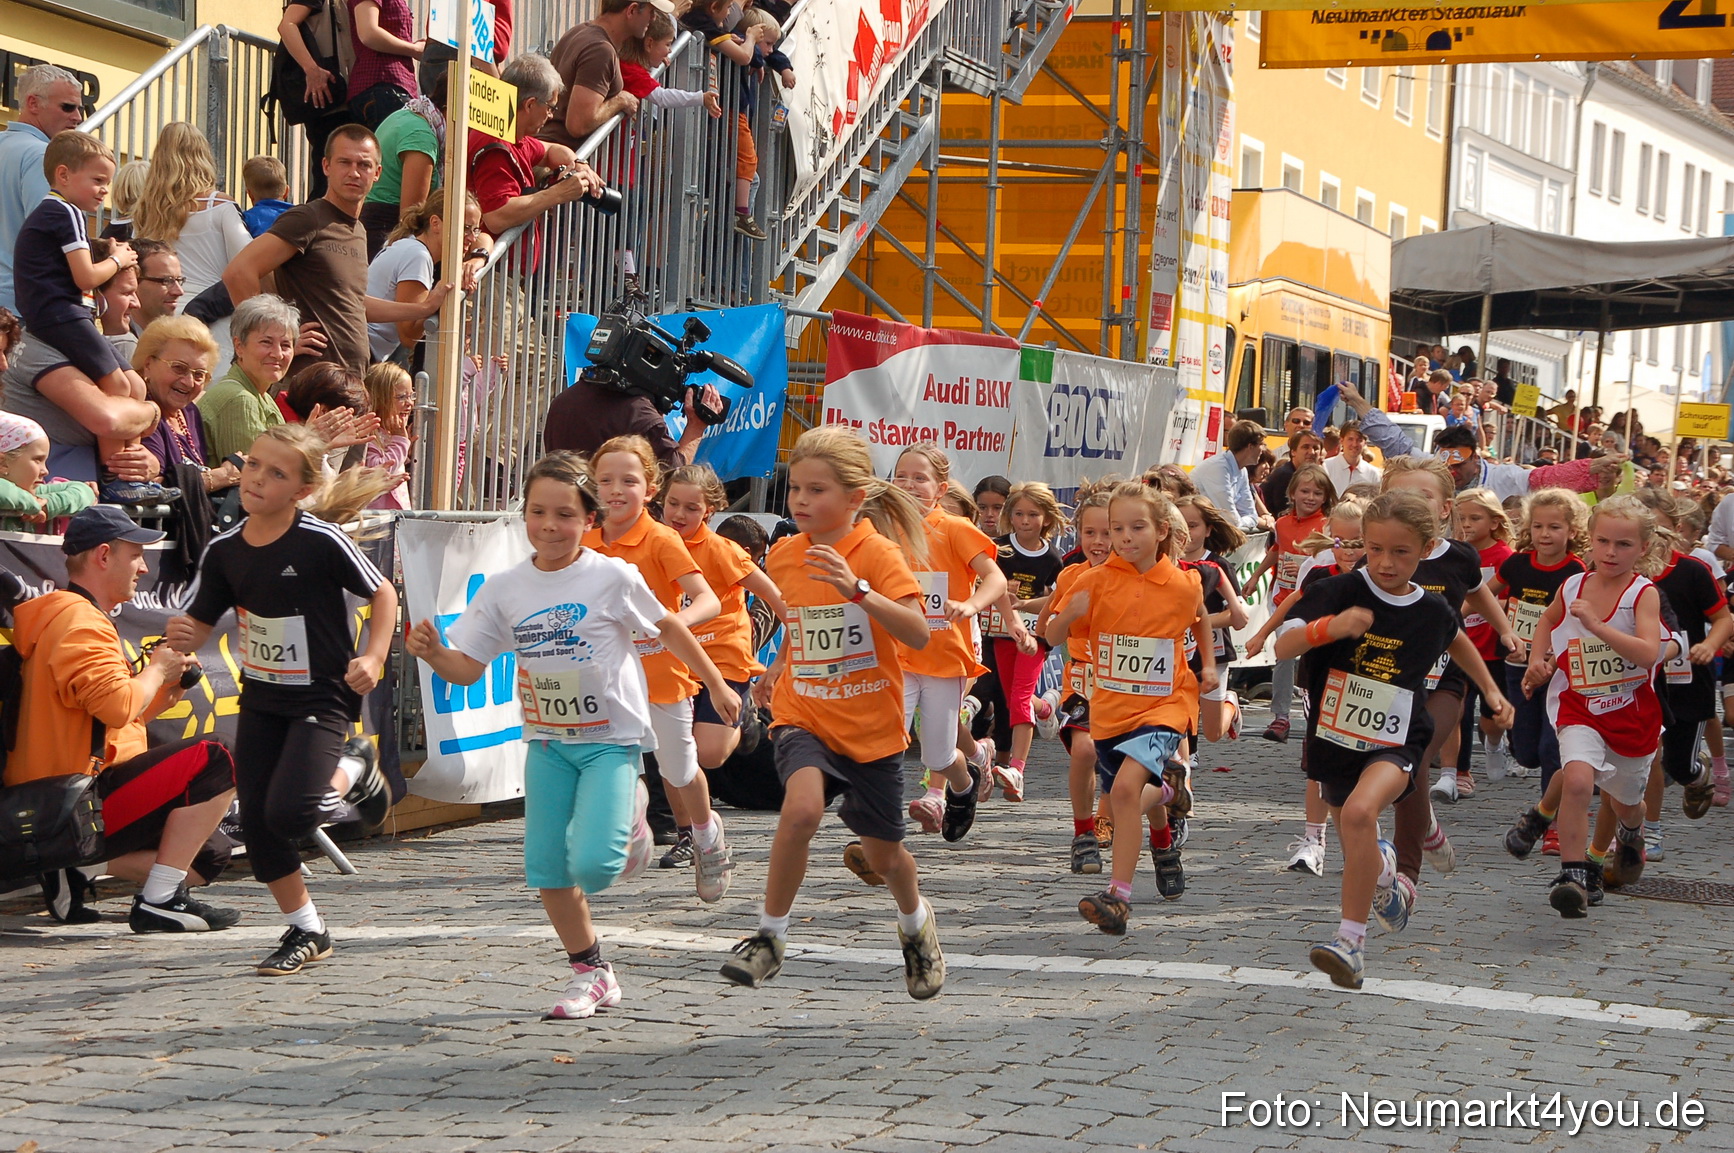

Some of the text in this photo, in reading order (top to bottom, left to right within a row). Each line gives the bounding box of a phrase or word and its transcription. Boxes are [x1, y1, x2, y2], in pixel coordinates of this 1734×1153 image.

[1311, 8, 1432, 24] Neumarkter
[923, 373, 970, 406] Audi
[868, 417, 940, 447] starker
[133, 581, 164, 610] und
[806, 624, 863, 651] 7075
[1116, 634, 1140, 648] Elisa
[1583, 642, 1611, 654] Laura
[250, 640, 298, 663] 7021
[555, 648, 575, 657] Sport
[1116, 654, 1167, 675] 7074
[534, 677, 561, 691] Julia
[842, 678, 891, 699] Reisen
[1347, 680, 1374, 700] Nina
[540, 695, 598, 717] 7016
[1325, 695, 1337, 708] K3
[1600, 696, 1624, 710] DEHN
[1344, 703, 1401, 735] 7093
